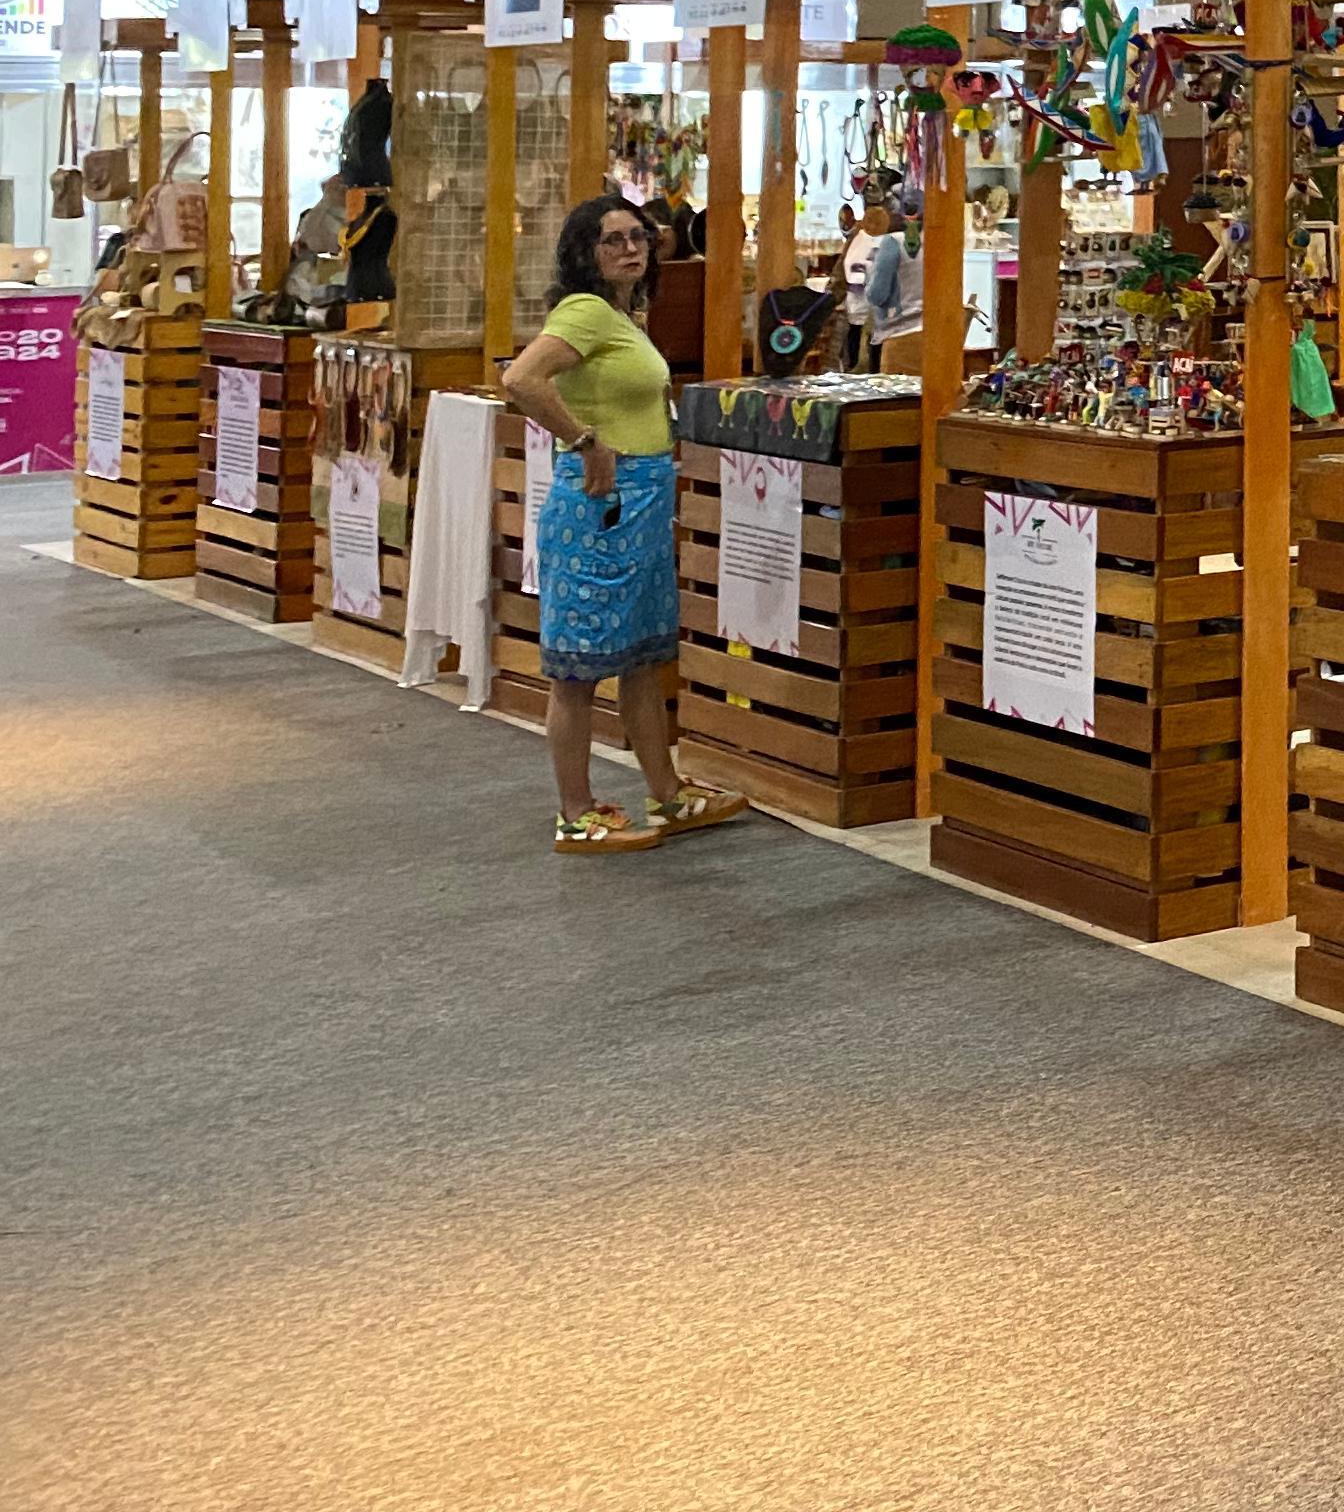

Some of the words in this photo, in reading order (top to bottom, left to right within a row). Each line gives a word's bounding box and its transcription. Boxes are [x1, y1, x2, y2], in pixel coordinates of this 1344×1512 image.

[0, 21, 45, 35] NDE
[18, 329, 63, 345] 20
[18, 345, 61, 361] 24
